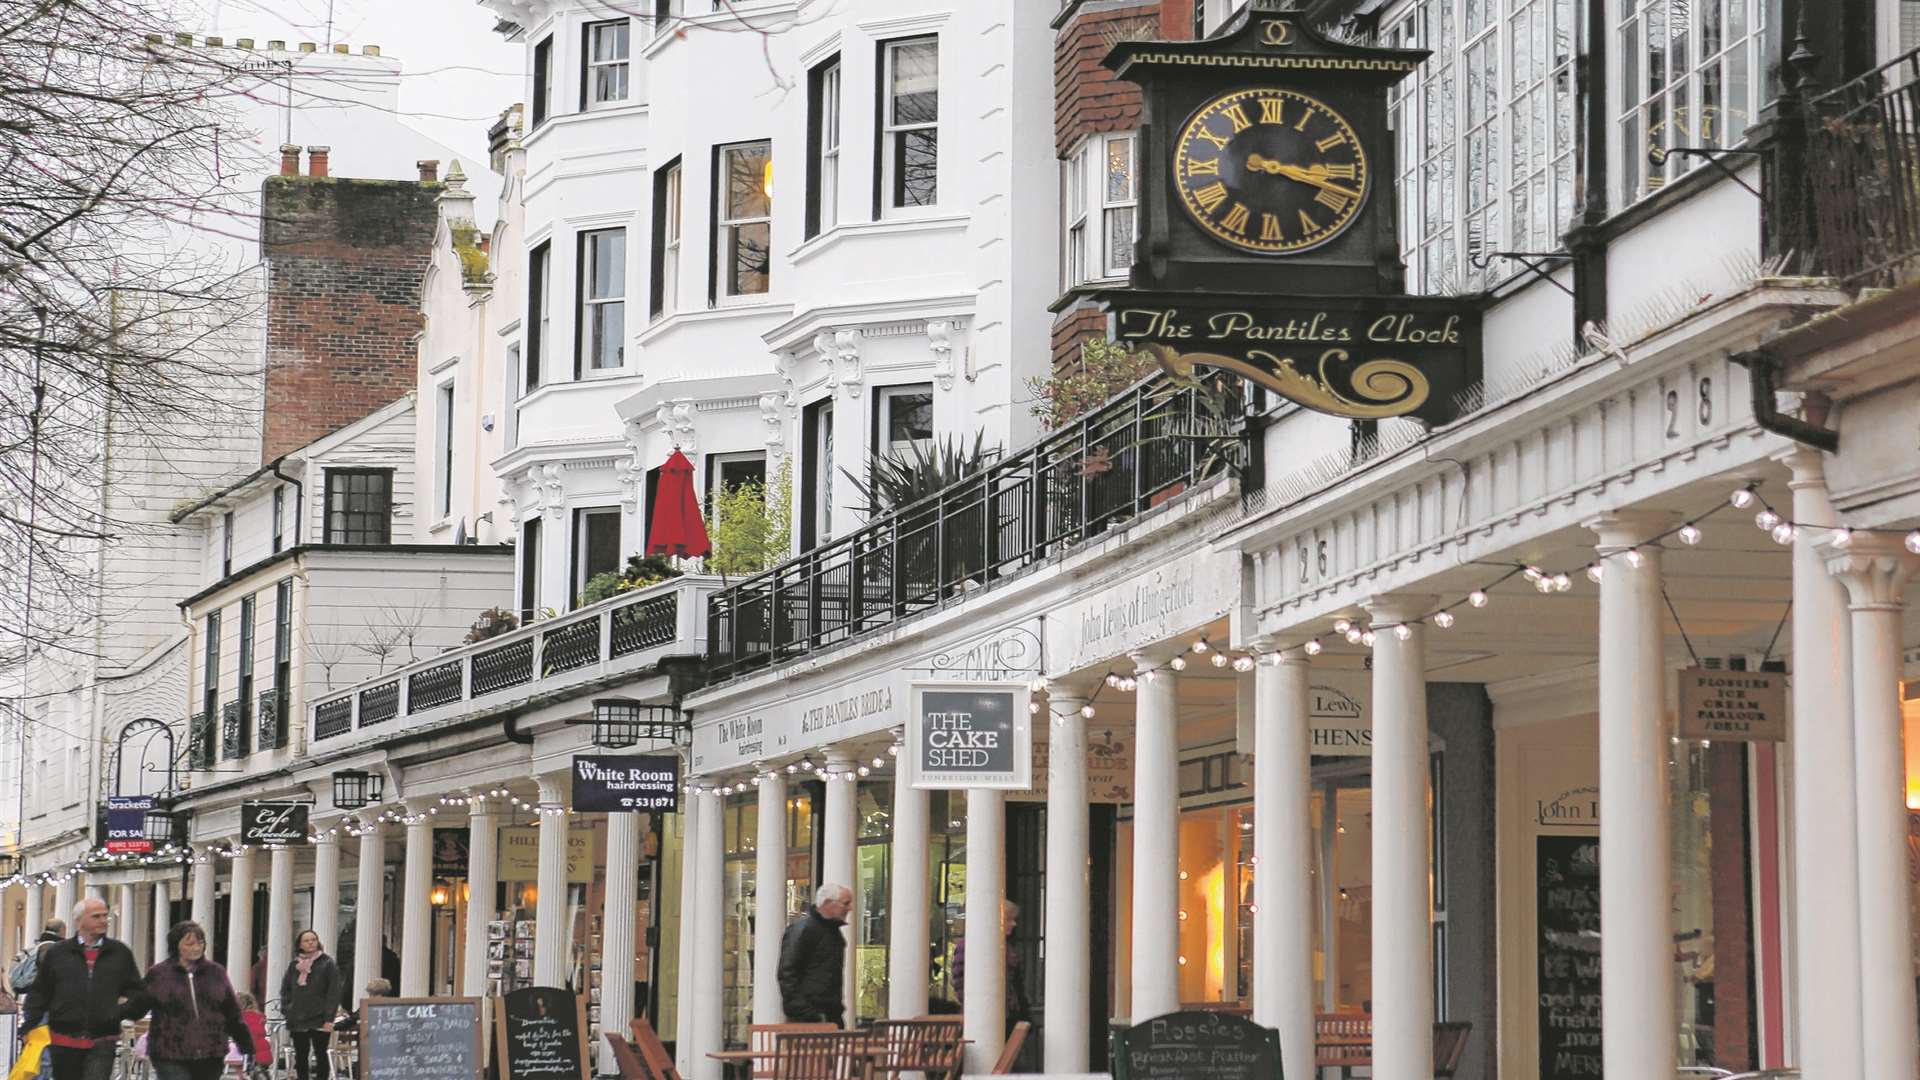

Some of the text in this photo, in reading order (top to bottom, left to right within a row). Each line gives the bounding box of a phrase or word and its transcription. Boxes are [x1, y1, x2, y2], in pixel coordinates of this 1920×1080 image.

[1120, 308, 1461, 344] The Pantiles Clock
[1665, 376, 1713, 440] 28
[1718, 689, 1745, 698] ICE
[1316, 695, 1363, 713] Lewis
[1702, 700, 1759, 710] CREAM
[808, 706, 825, 732] THE
[927, 711, 973, 731] THE
[1697, 710, 1767, 721] PARLOUR
[717, 715, 763, 745] The White Room
[928, 730, 999, 749] CAKE
[576, 760, 598, 769] The
[928, 748, 990, 768] SHED
[578, 768, 674, 781] White Room
[606, 781, 674, 793] hairdressing
[635, 797, 675, 808] 531871
[1535, 799, 1582, 824] John
[108, 829, 144, 838] FOR SAL
[406, 1005, 437, 1018] CAKE
